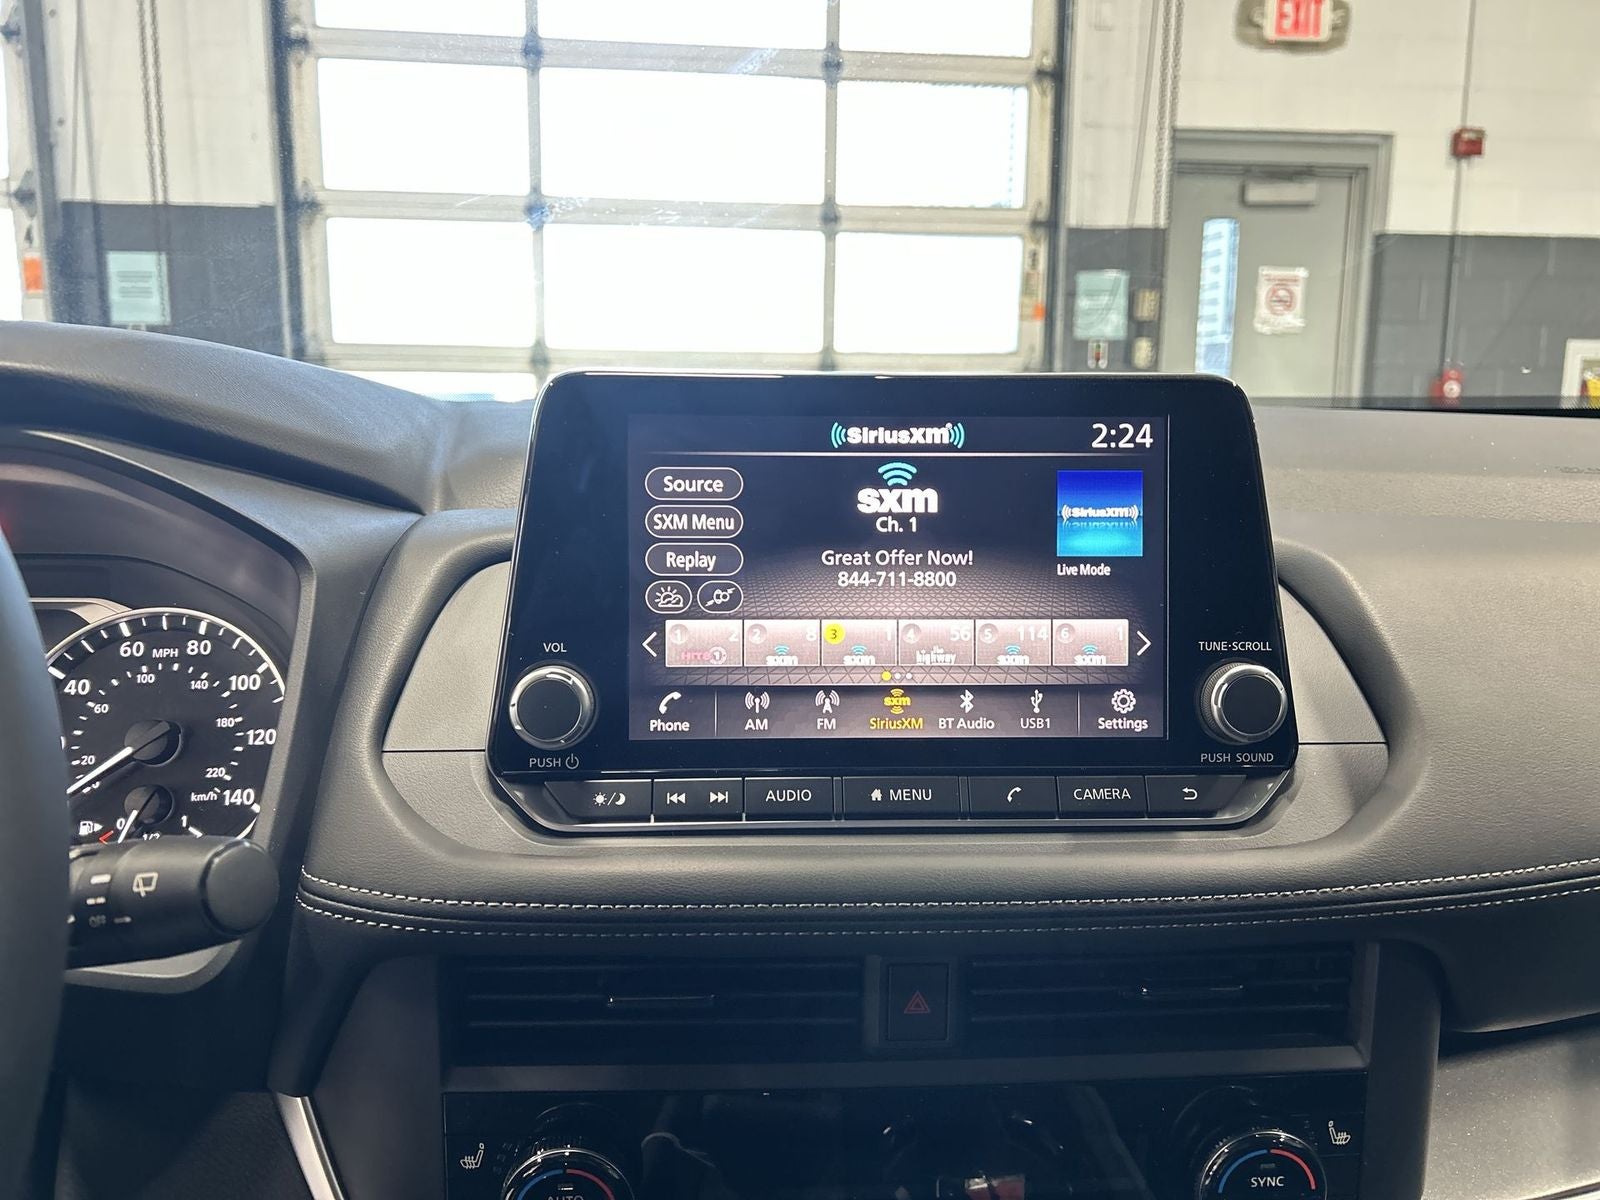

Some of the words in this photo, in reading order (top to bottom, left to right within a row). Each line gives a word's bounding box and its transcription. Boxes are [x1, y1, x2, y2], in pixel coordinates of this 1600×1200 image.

[1275, 0, 1322, 37] EXIT
[1091, 423, 1153, 448] 2:24
[663, 475, 724, 492] Source
[857, 488, 939, 514] sxm
[653, 513, 688, 530] SXM
[692, 513, 735, 530] Menu
[875, 516, 904, 532] Ch.
[909, 517, 917, 532] 1
[666, 551, 717, 572] Replay
[821, 550, 871, 566] Great
[875, 549, 922, 566] Offer
[927, 550, 973, 566] Now!
[1056, 563, 1079, 576] Live
[1079, 563, 1111, 576] Mode
[837, 571, 957, 587] 844-711-8800
[674, 629, 683, 642] 1
[729, 630, 739, 641] 2
[752, 629, 762, 641] 2
[805, 629, 817, 641] 8
[829, 629, 838, 640] 3
[885, 628, 893, 641] 1
[905, 628, 915, 640] 4
[950, 626, 971, 641] 56
[984, 628, 993, 640] 5
[1017, 626, 1049, 641] 114
[1060, 628, 1069, 640] 6
[1116, 626, 1124, 641] 1
[120, 641, 144, 657] 60
[152, 648, 179, 658] MPH
[186, 640, 212, 656] 80
[543, 642, 567, 653] VOL
[136, 673, 155, 684] 100
[190, 680, 209, 690] 140
[229, 674, 261, 691] 100
[64, 679, 91, 695] 40
[94, 703, 109, 714] 60
[216, 717, 235, 728] 180
[650, 719, 690, 732] Phone
[744, 718, 768, 730] AM
[817, 718, 836, 730] FM
[870, 717, 923, 730] SiriusXM
[938, 718, 954, 729] BT
[956, 717, 995, 730] Audio
[1020, 718, 1050, 729] USB1
[1098, 717, 1148, 732] Settings
[246, 728, 277, 745] 120
[80, 755, 96, 766] 20
[529, 758, 561, 768] PUSH
[1200, 752, 1231, 763] PUSH
[1236, 752, 1274, 763] SOUND
[205, 767, 226, 778] 220
[191, 792, 217, 802] km/h
[223, 788, 254, 806] 140
[765, 788, 812, 802] AUDIO
[889, 788, 932, 801] MENU
[1073, 787, 1132, 801] CAMERA
[116, 817, 126, 830] 0
[181, 815, 188, 827] 1
[1250, 1175, 1285, 1188] SYNC
